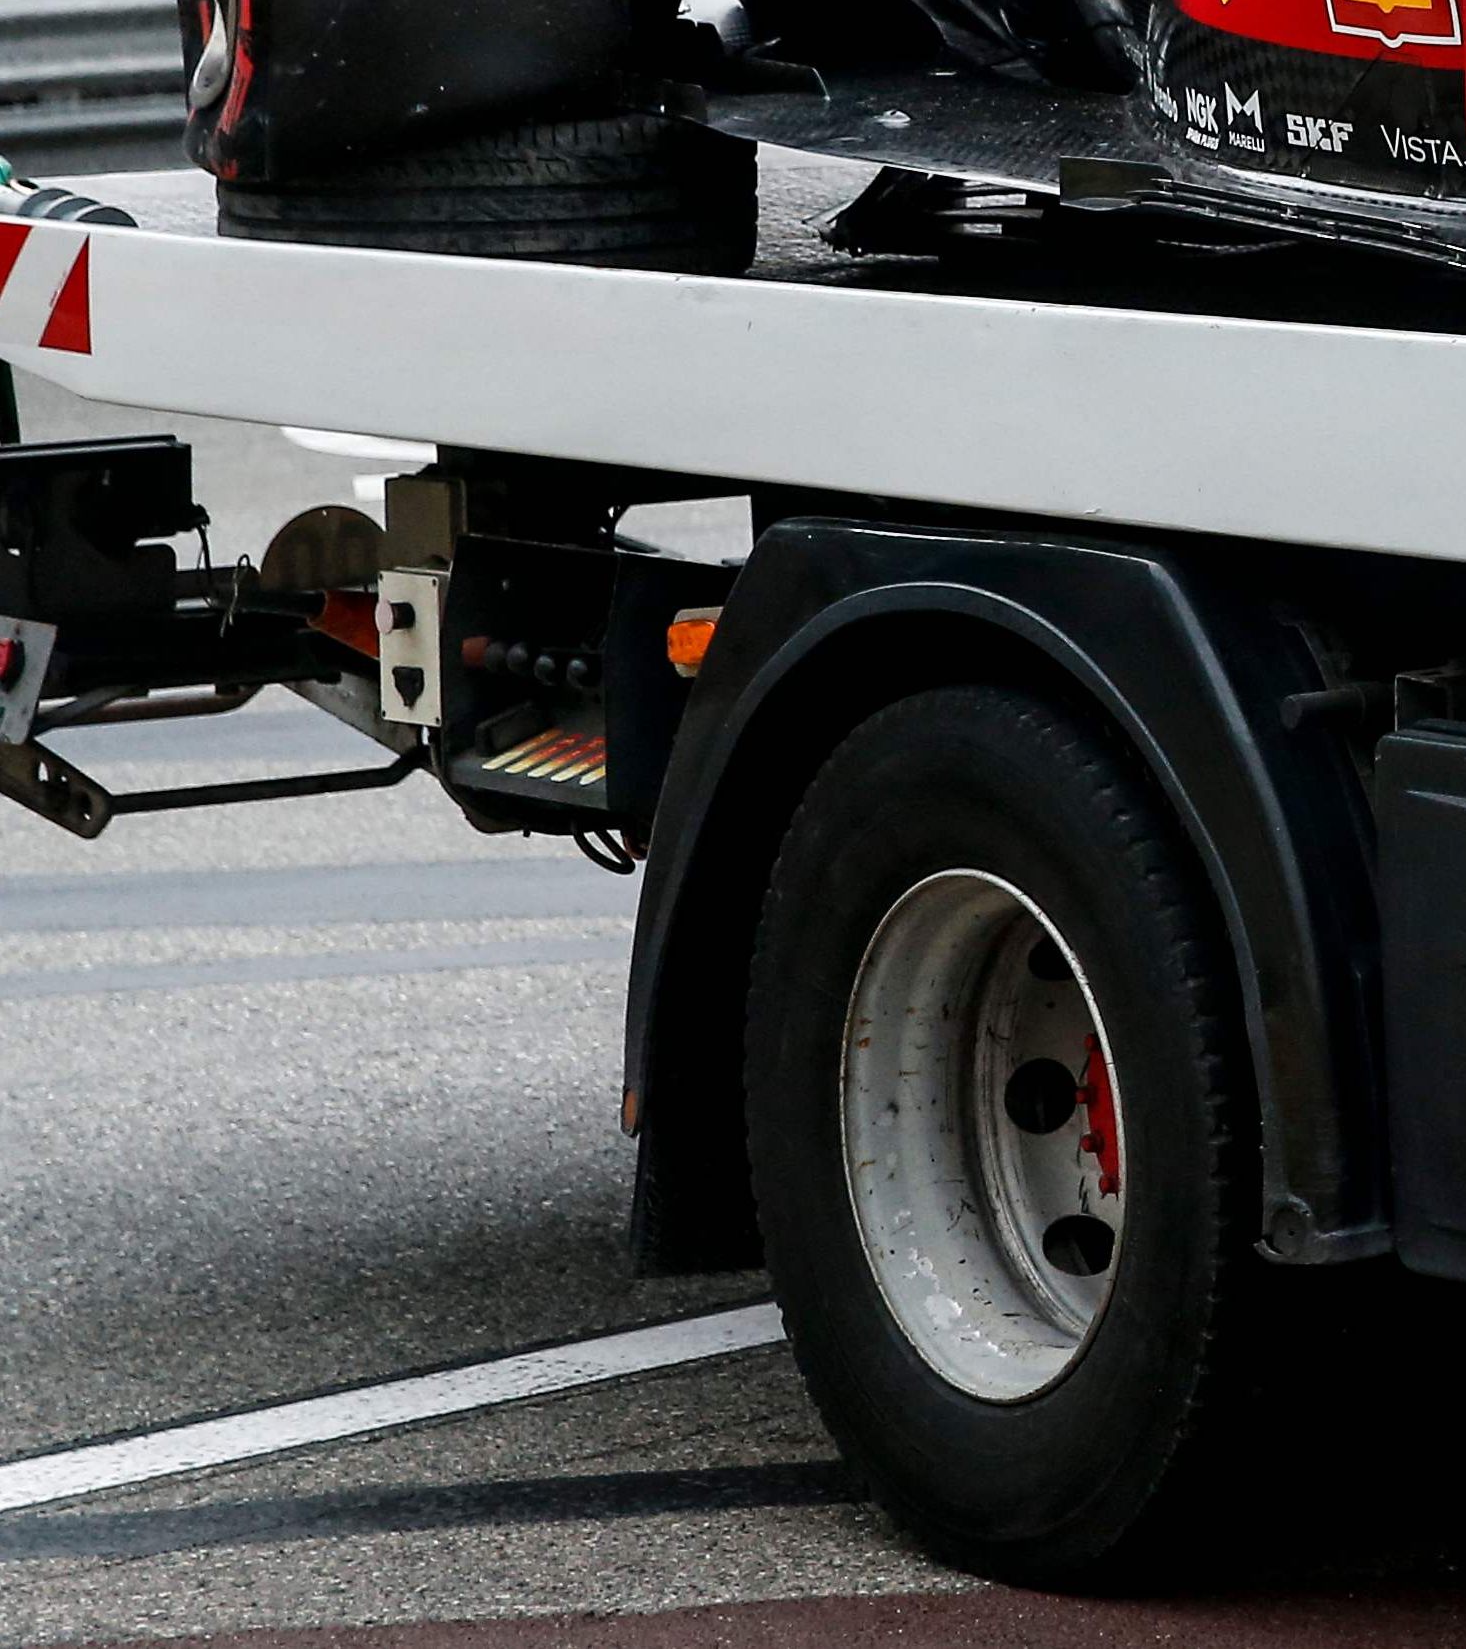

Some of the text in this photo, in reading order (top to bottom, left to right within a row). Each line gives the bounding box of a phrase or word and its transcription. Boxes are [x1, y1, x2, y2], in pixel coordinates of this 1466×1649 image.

[1185, 86, 1219, 135] NGK
[1228, 130, 1265, 153] MARELLI
[1286, 113, 1354, 153] SKF
